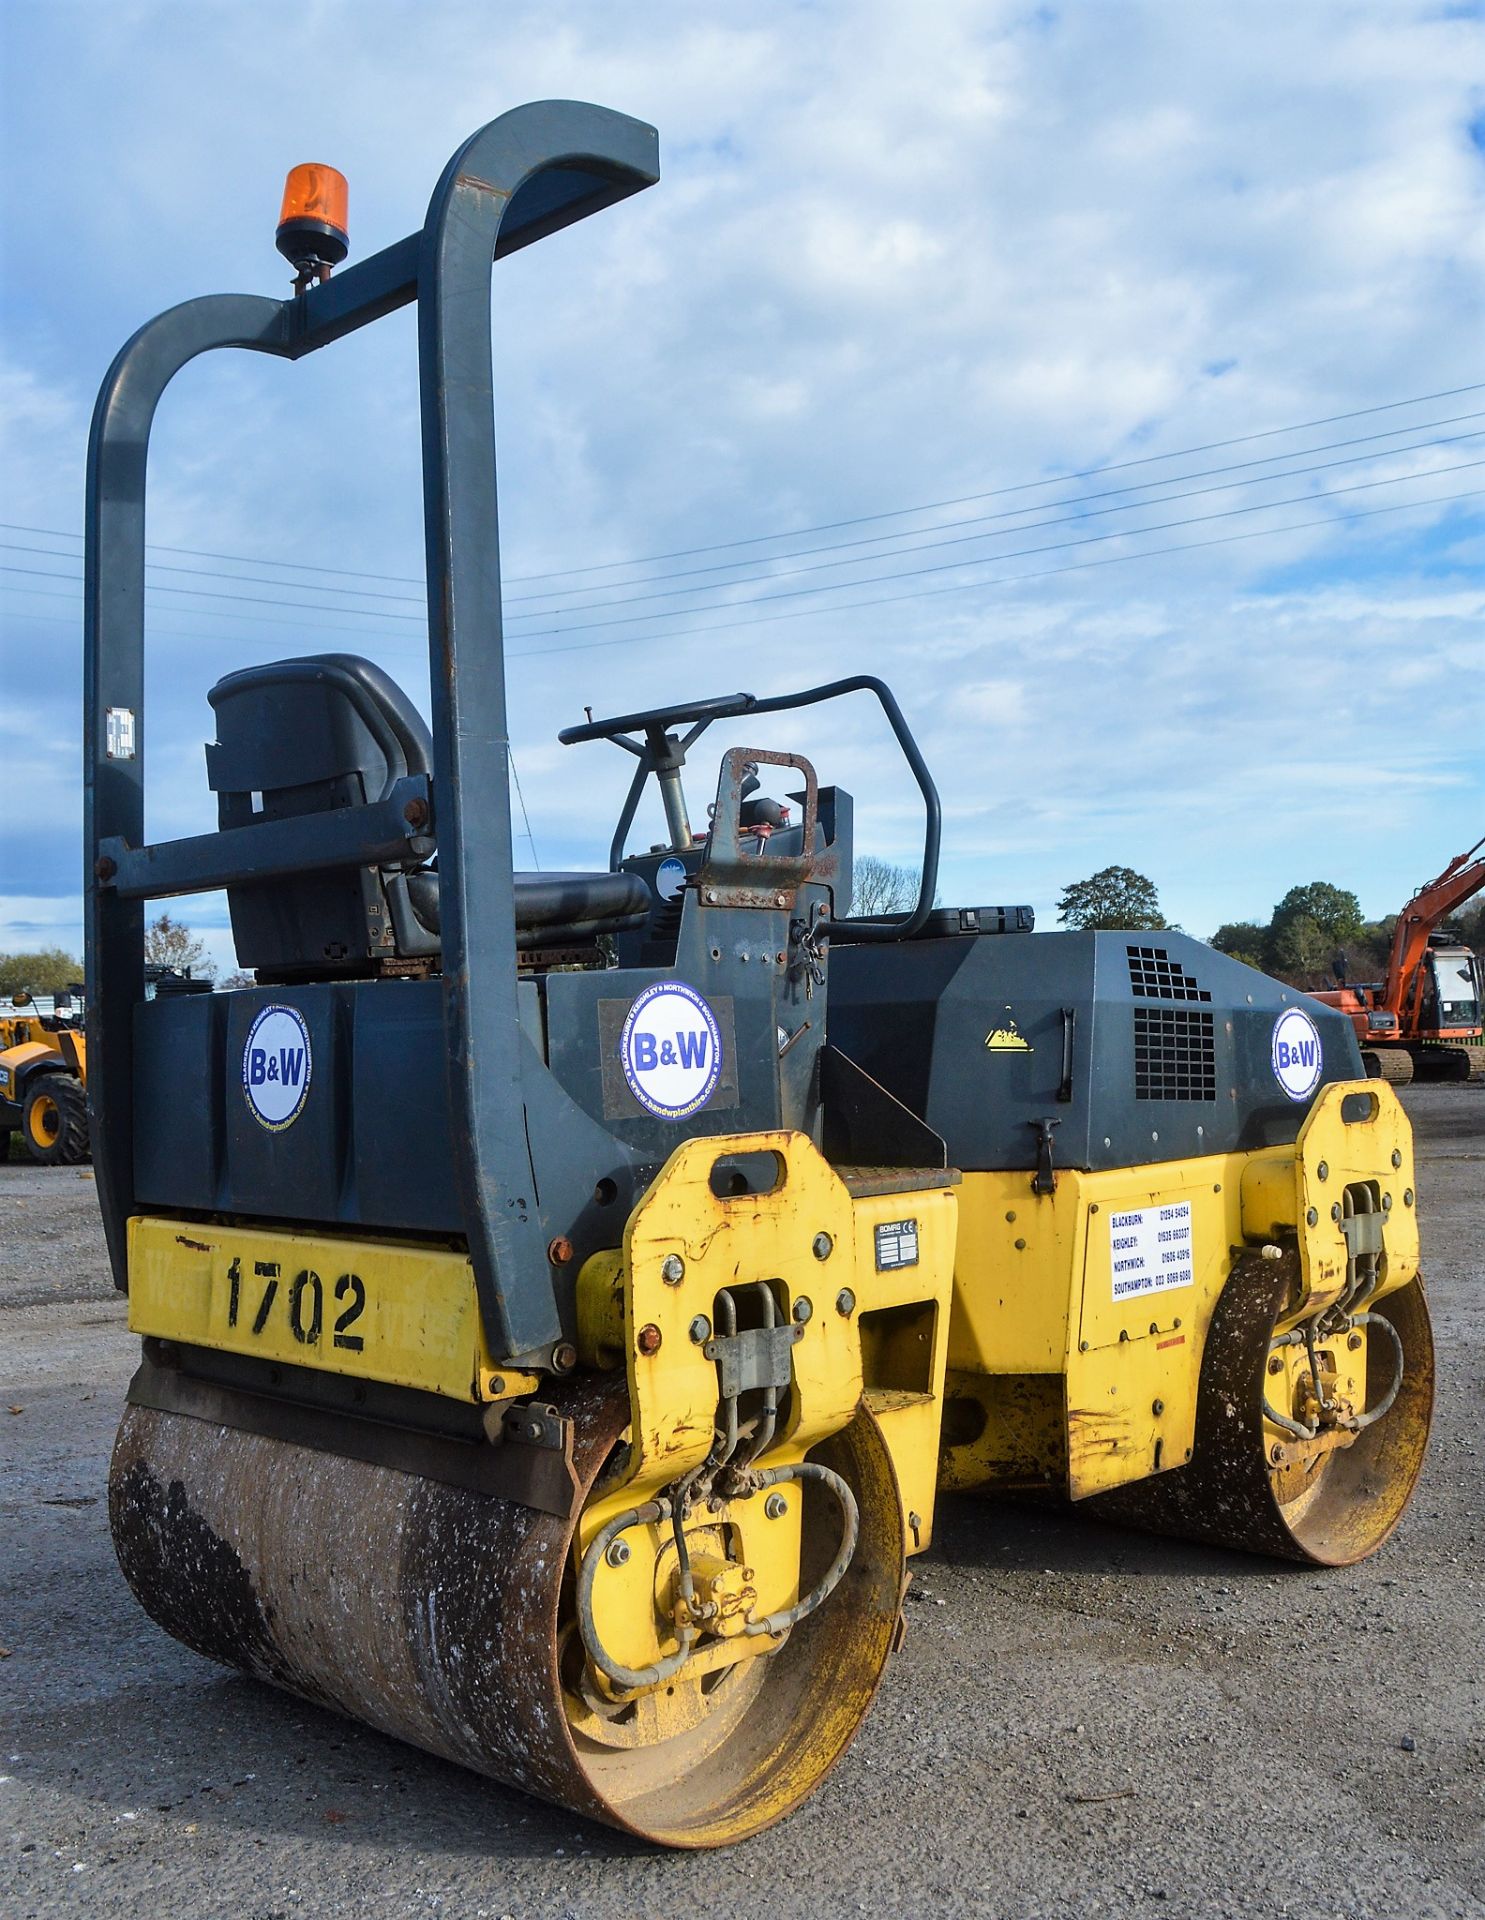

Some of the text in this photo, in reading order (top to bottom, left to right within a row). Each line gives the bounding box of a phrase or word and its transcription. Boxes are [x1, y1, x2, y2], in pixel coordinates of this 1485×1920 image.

[622, 1018, 633, 1070] BLACKBURN
[634, 986, 659, 1014] KEIGHLEY
[702, 1005, 720, 1064] SOUTHAMPTON
[634, 1031, 708, 1071] B&W
[1278, 1041, 1314, 1069] B&W
[250, 1048, 304, 1086] B&W
[630, 1074, 717, 1118] www.bandwplanthire.com
[880, 1223, 901, 1233] BOMAG
[1112, 1214, 1143, 1229] BLACKBURN:
[1113, 1236, 1138, 1251] KEIGHLEY:
[1114, 1256, 1145, 1273] NORTHWICH:
[1114, 1277, 1153, 1295] SOUTHAMPTON:
[227, 1257, 365, 1351] 1702
